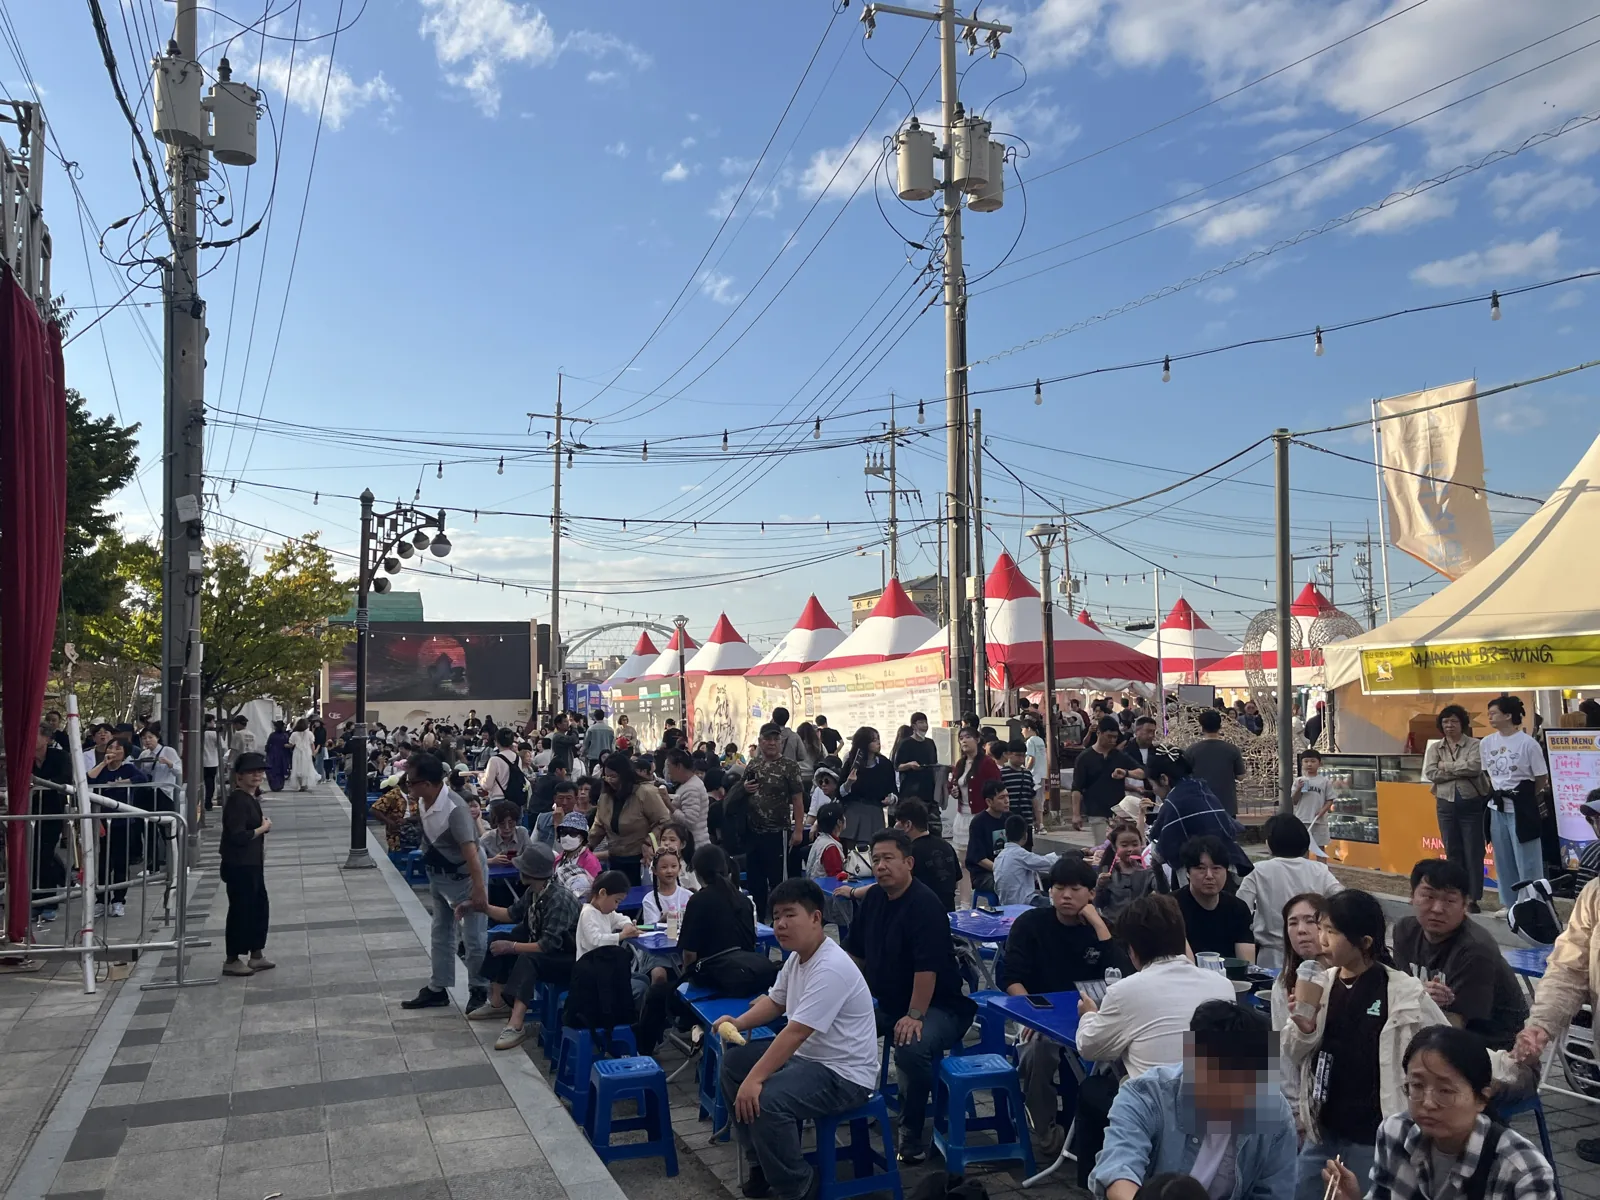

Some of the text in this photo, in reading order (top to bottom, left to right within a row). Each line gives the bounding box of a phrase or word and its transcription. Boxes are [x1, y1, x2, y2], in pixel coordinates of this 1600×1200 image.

[1411, 644, 1553, 669] MAINKUN BREWING
[1550, 737, 1593, 746] BEER MENU
[1422, 837, 1444, 849] MAIN
